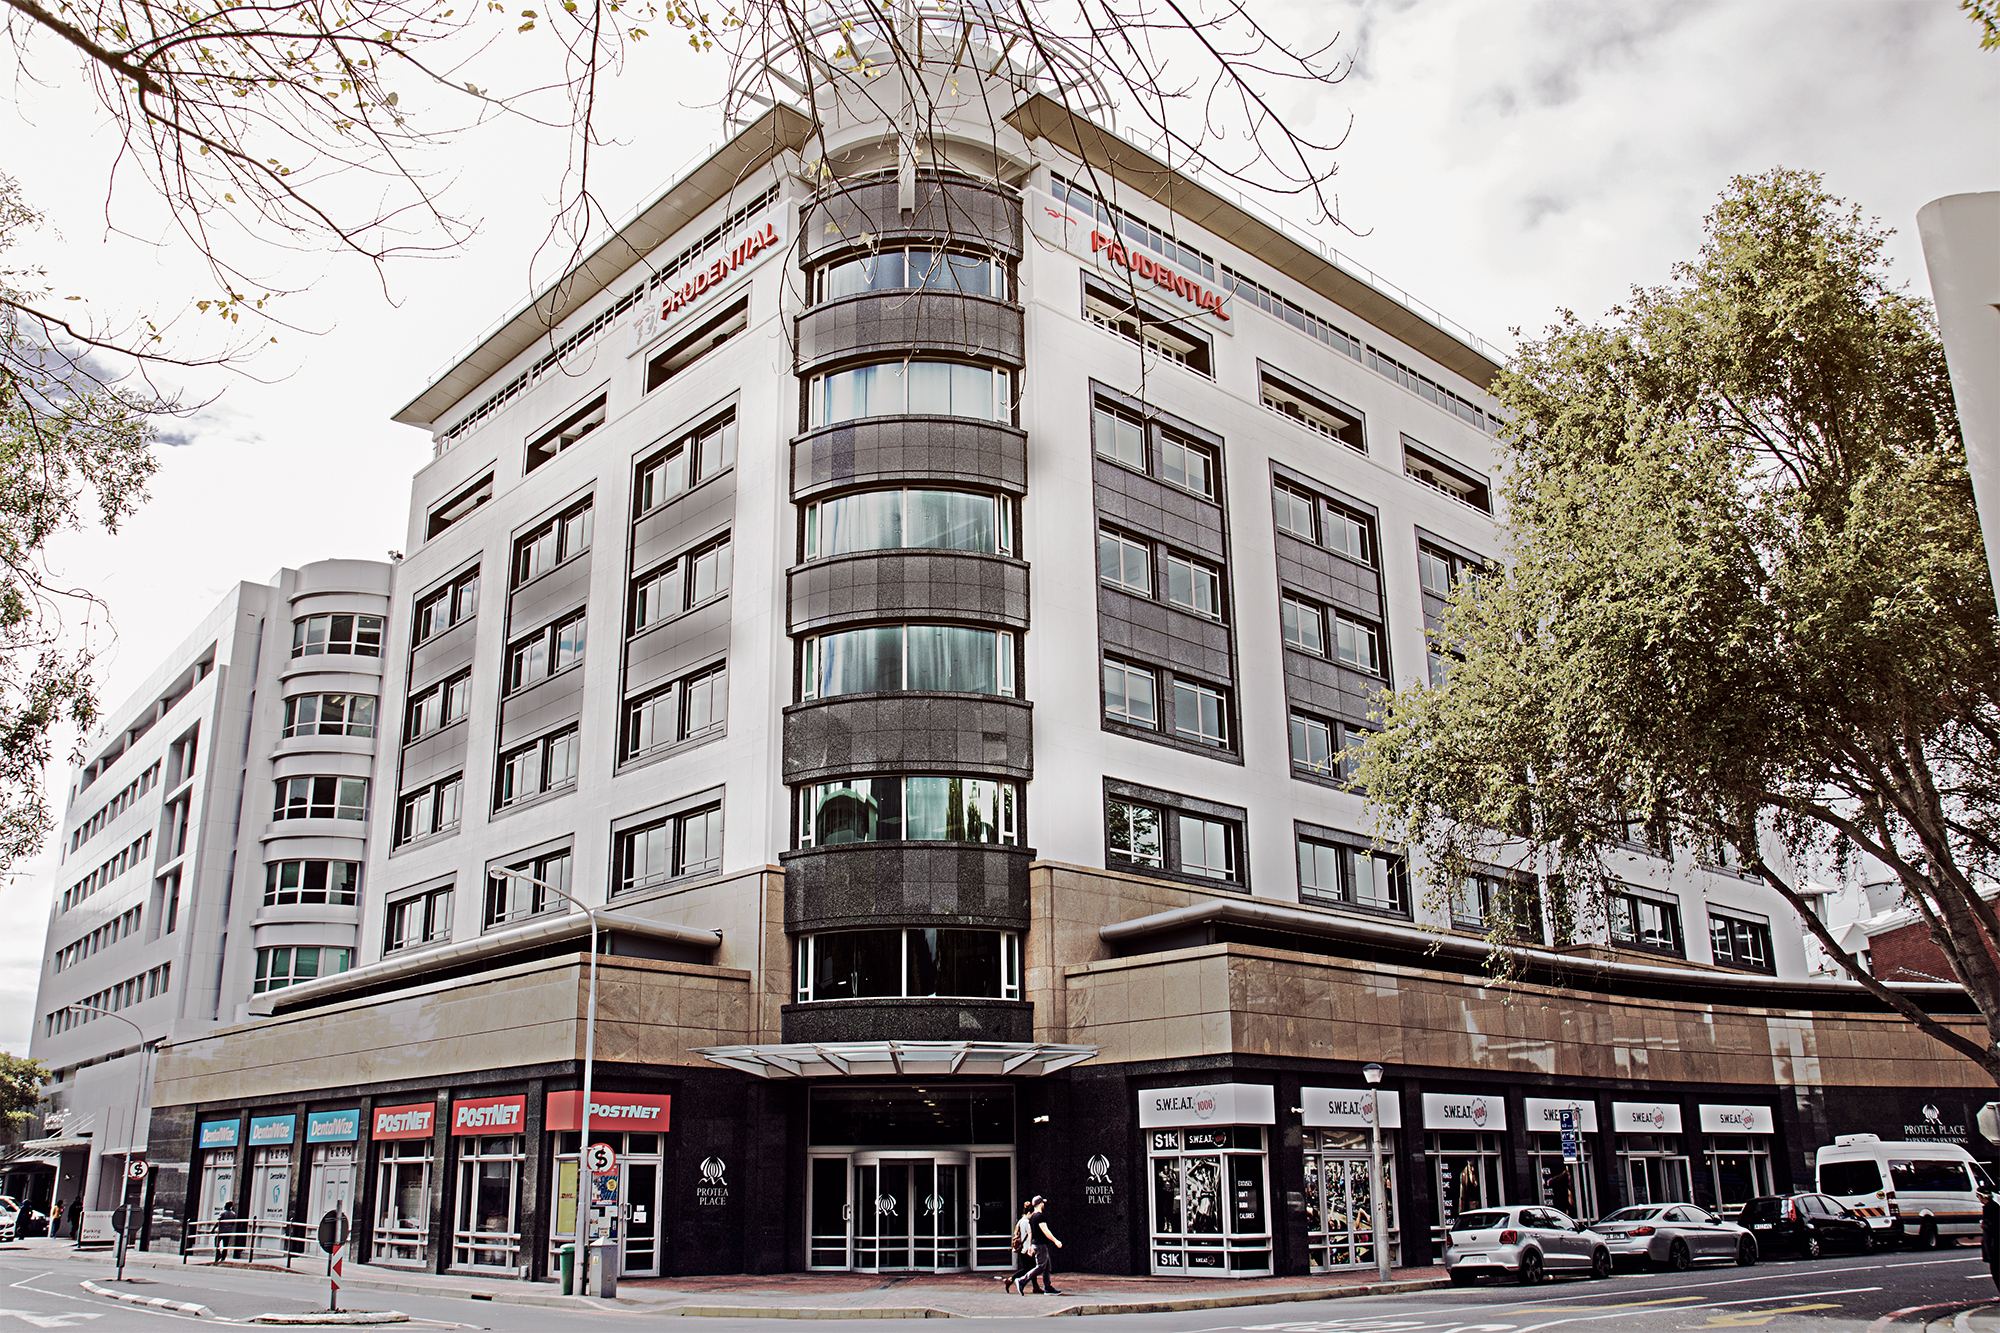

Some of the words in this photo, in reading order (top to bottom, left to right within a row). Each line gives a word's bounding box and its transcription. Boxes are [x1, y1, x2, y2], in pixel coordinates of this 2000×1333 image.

[660, 222, 779, 321] PRUDENTIAL
[1091, 230, 1231, 321] PRUDENTIAL
[1196, 1099, 1213, 1112] 1000
[1562, 1113, 1570, 1122] P
[252, 1122, 290, 1140] DentalWize
[311, 1117, 354, 1136] DentalWize
[1904, 1125, 1936, 1135] PROTEA
[1938, 1125, 1967, 1135] PLACE
[202, 1126, 235, 1143] DentalWize
[1155, 1132, 1178, 1148] S1K
[696, 1187, 729, 1196] PROTEA
[1085, 1186, 1114, 1195] PROTEA
[699, 1196, 727, 1206] PLACE
[1088, 1194, 1112, 1204] PLACE
[1161, 1252, 1180, 1266] S1K
